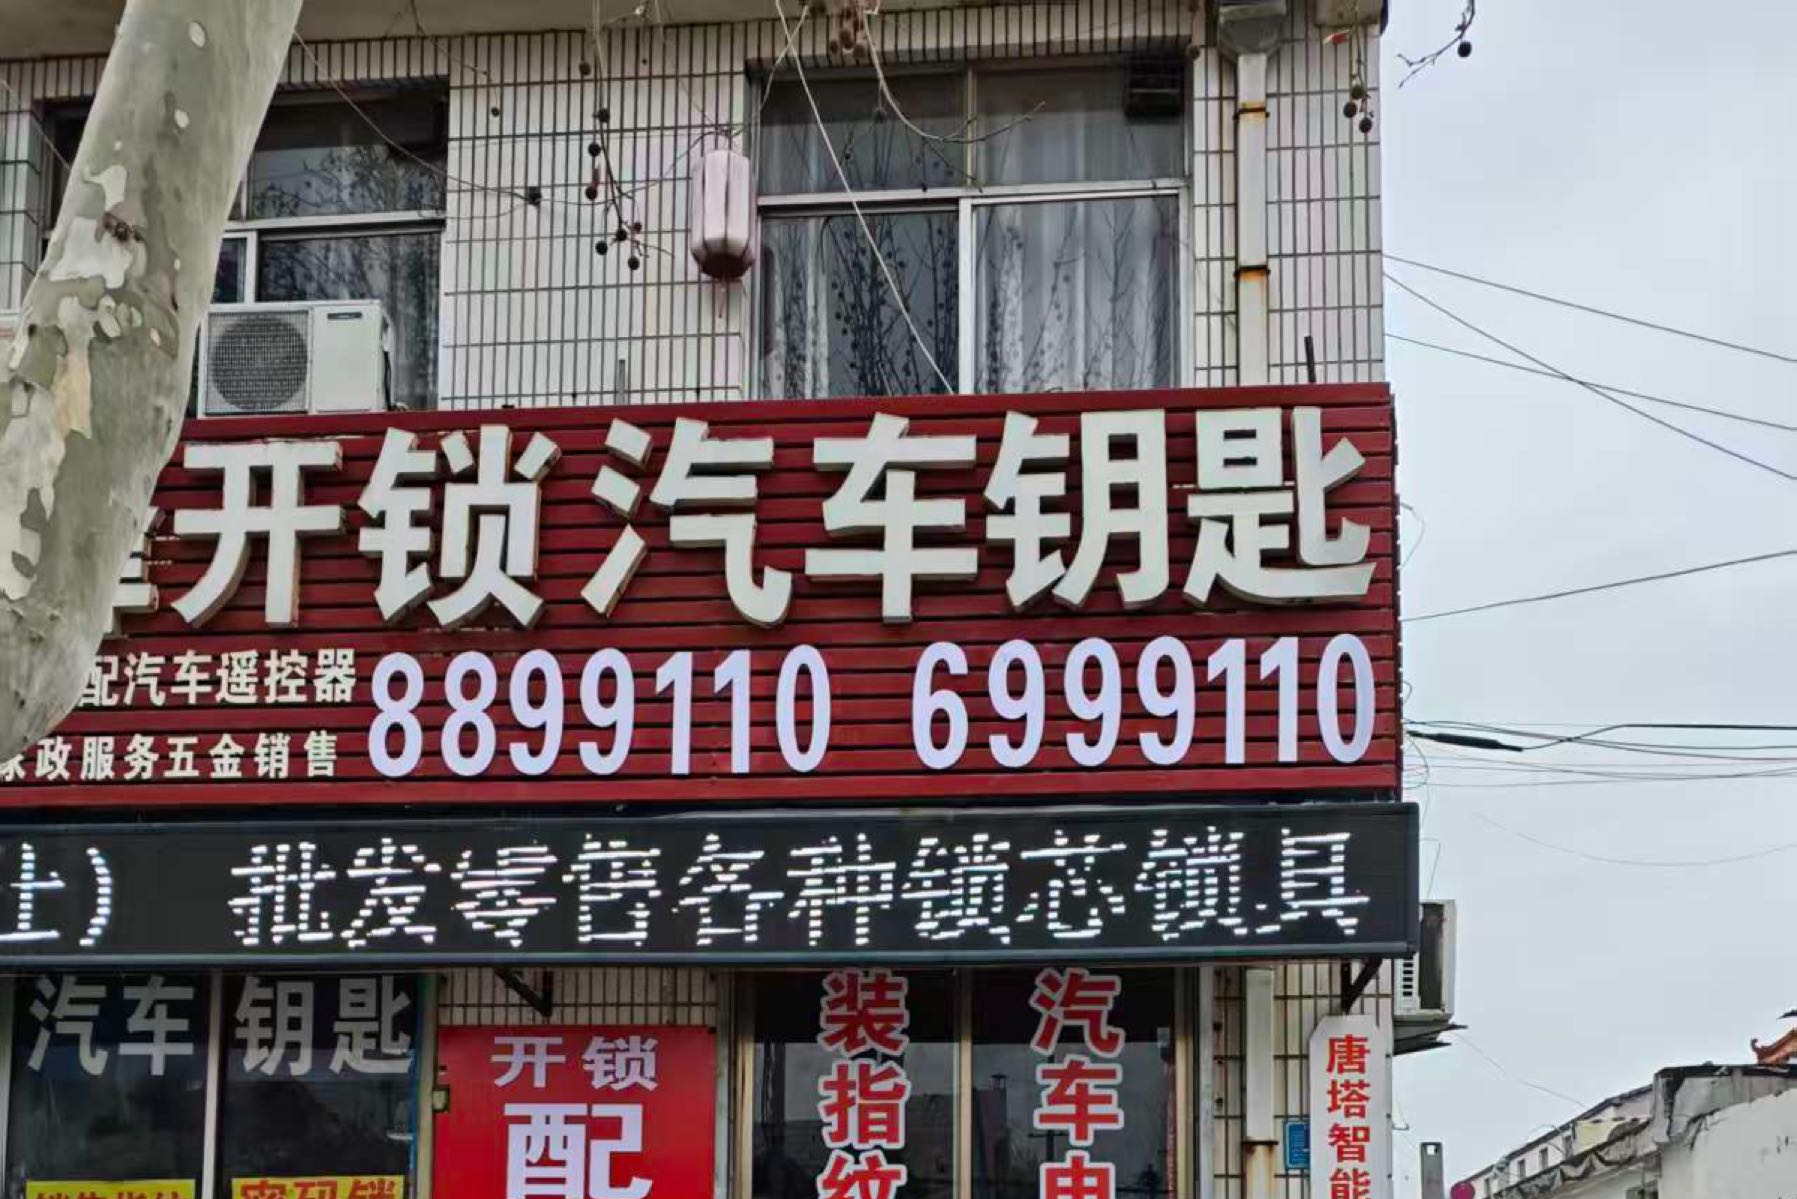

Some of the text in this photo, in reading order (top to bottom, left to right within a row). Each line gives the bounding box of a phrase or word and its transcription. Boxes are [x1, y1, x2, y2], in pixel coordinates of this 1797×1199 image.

[104, 405, 1376, 629] 开锁汽车钥匙
[368, 633, 1375, 777] 8899110 6999110
[227, 827, 1370, 947] 批发零售各种锁芯锁具
[492, 1035, 660, 1092] 开锁
